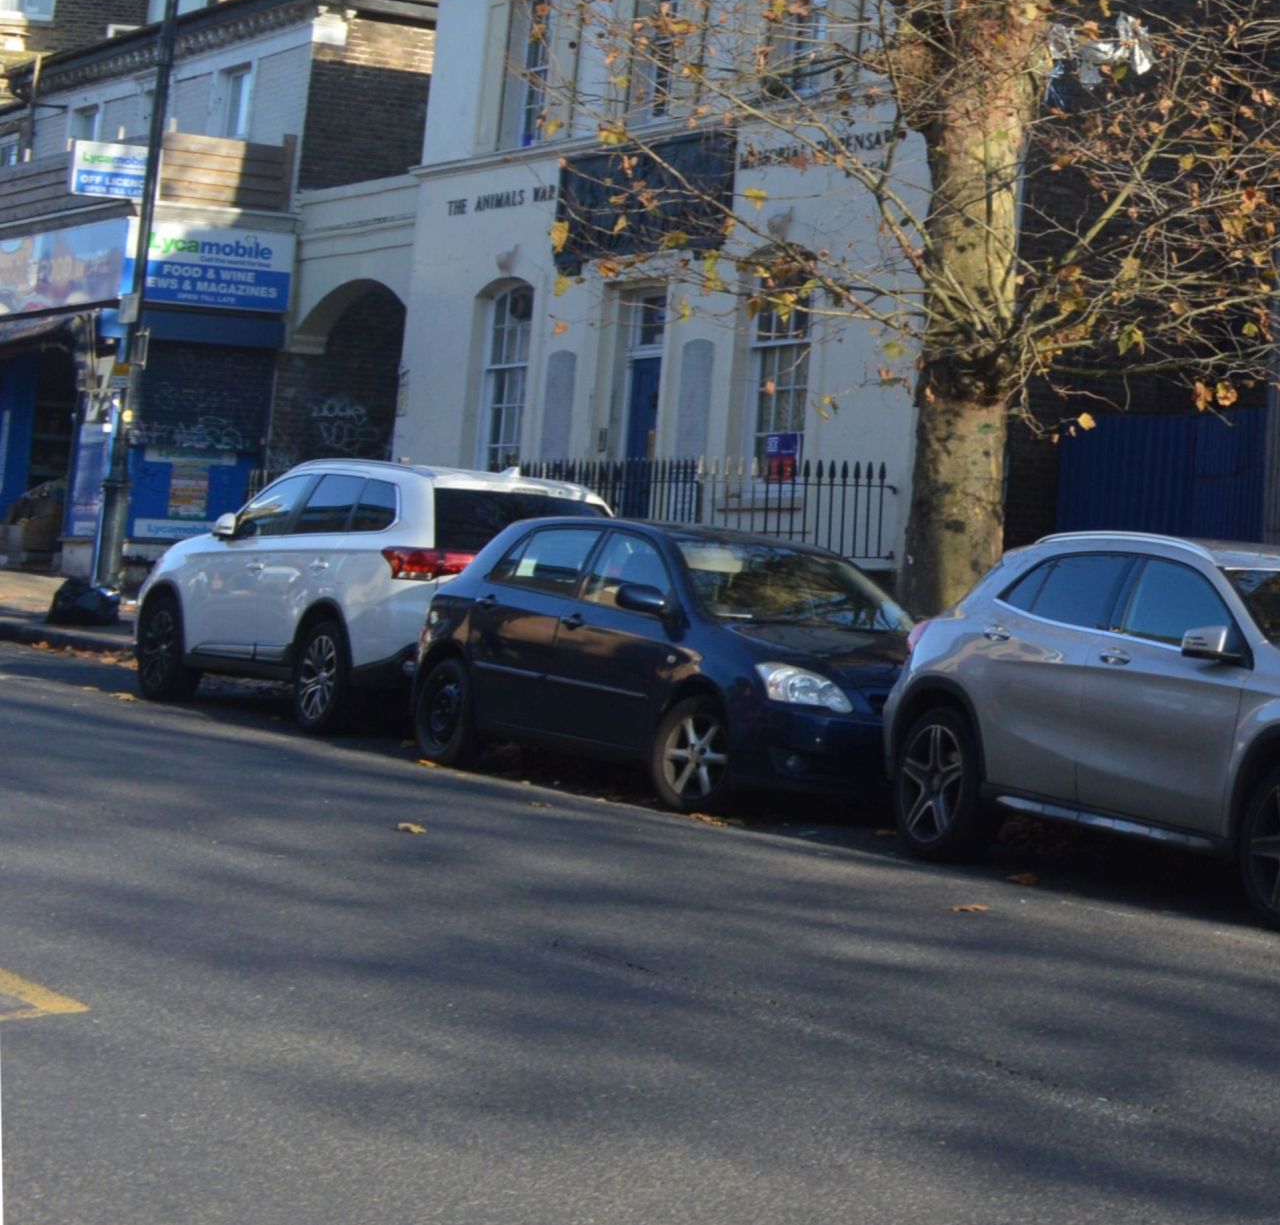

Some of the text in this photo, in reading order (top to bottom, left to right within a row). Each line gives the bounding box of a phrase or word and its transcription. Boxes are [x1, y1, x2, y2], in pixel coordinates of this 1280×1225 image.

[446, 197, 468, 217] THE
[474, 189, 525, 213] ANIMALS
[149, 232, 273, 260] Lycamobile
[163, 264, 256, 282] FOOD & WINE
[146, 276, 278, 298] EWS & MAGAZINES
